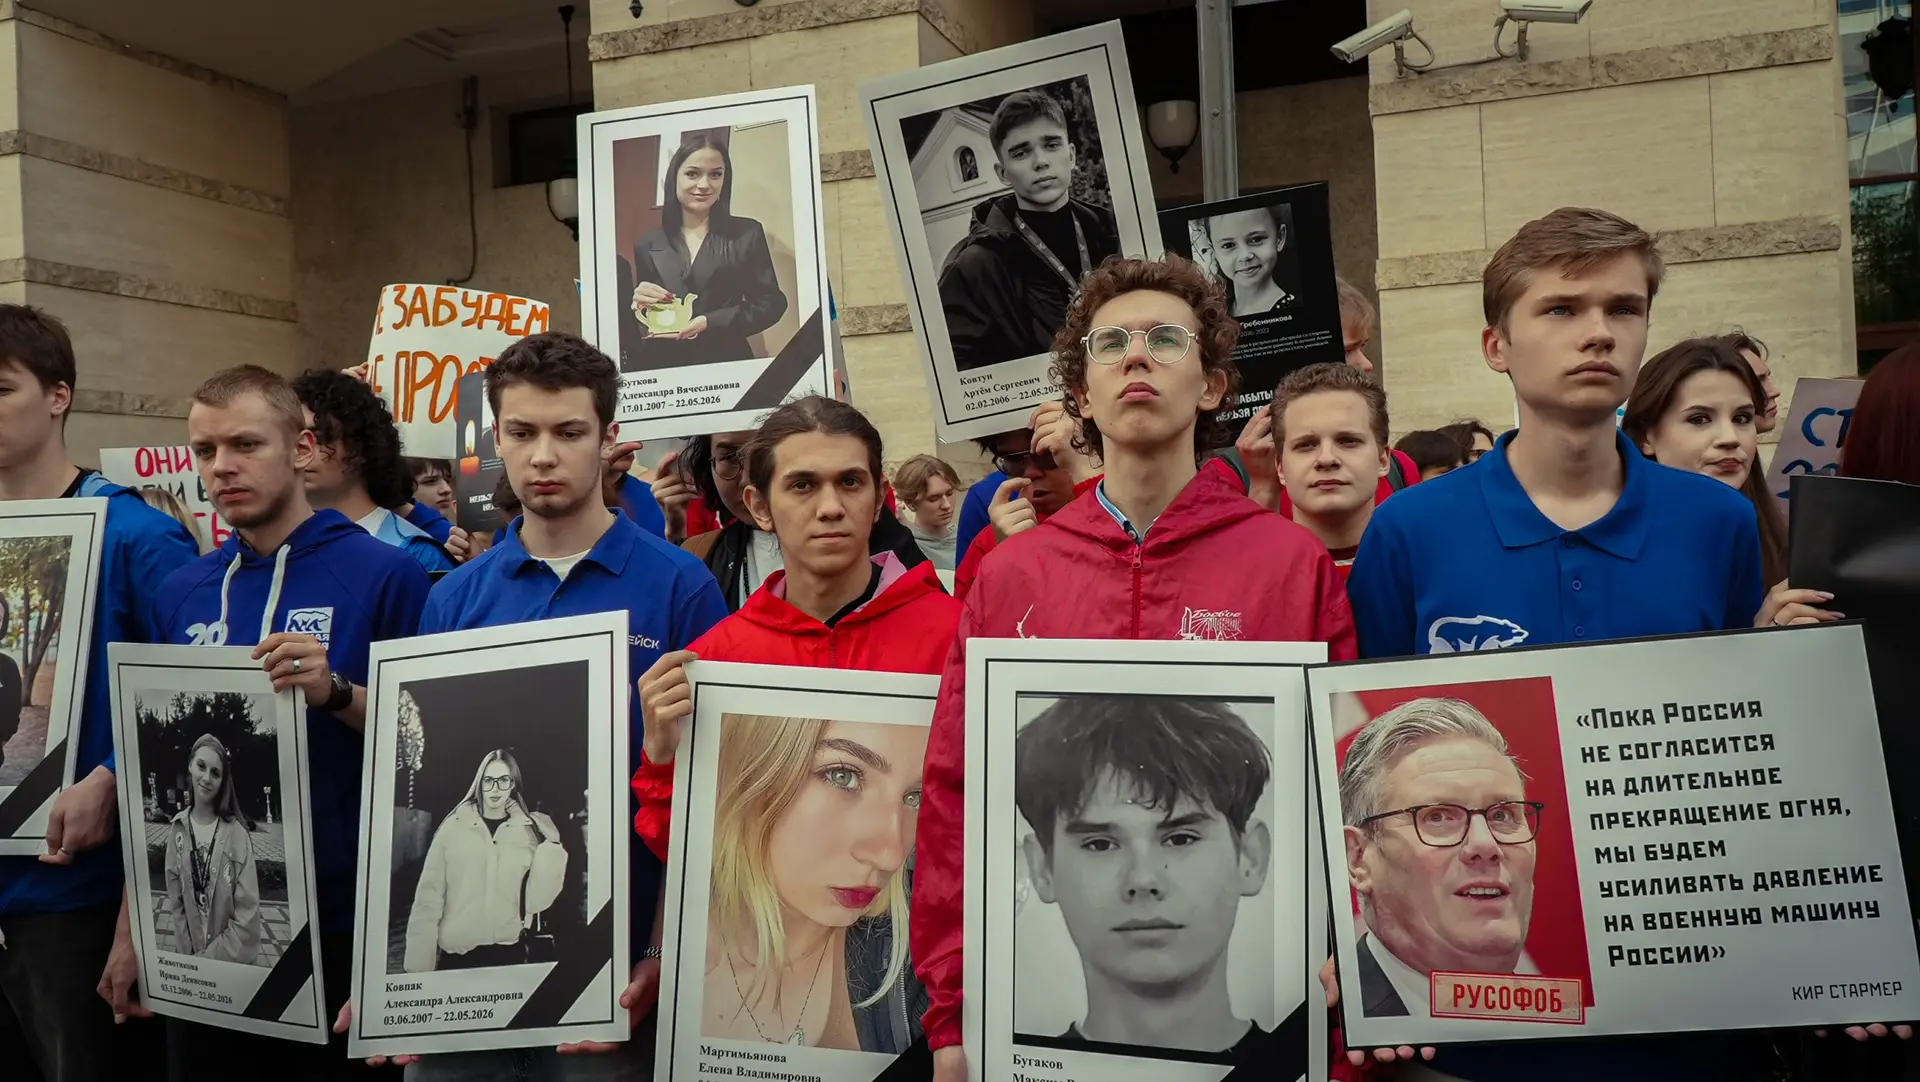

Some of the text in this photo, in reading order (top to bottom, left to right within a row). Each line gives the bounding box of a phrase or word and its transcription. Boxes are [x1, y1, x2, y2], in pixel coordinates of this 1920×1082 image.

[392, 284, 549, 336] ЗАБУДЕМ
[621, 377, 658, 389] Буткова
[960, 373, 993, 386] Ковтун
[963, 376, 1041, 399] Артём Сергеевич
[621, 382, 740, 400] Александра Вячеславовна
[622, 401, 666, 413] 17.01.2007
[675, 395, 721, 408] 22.05.2026
[965, 396, 1010, 411] 02.02.2006
[135, 446, 192, 477] ОНИ
[469, 493, 494, 503] НЕЛЬЗ
[159, 969, 217, 988] Ирина Денисовна
[385, 982, 423, 993] Ковпак
[161, 983, 192, 997] 03.12.2006
[199, 991, 233, 1004] 22.05.2026
[1453, 983, 1562, 1013] РУСОФОБ
[1792, 981, 1902, 1000] КИР СТАРМЕР
[384, 992, 524, 1010] Александра Александровна
[383, 1013, 433, 1025] 03.06.2007
[444, 1009, 494, 1021] 22.05.2026
[700, 1045, 787, 1063] Мартимьянова
[1013, 1054, 1063, 1069] Бугаков
[699, 1062, 821, 1082] Елена Владимировна
